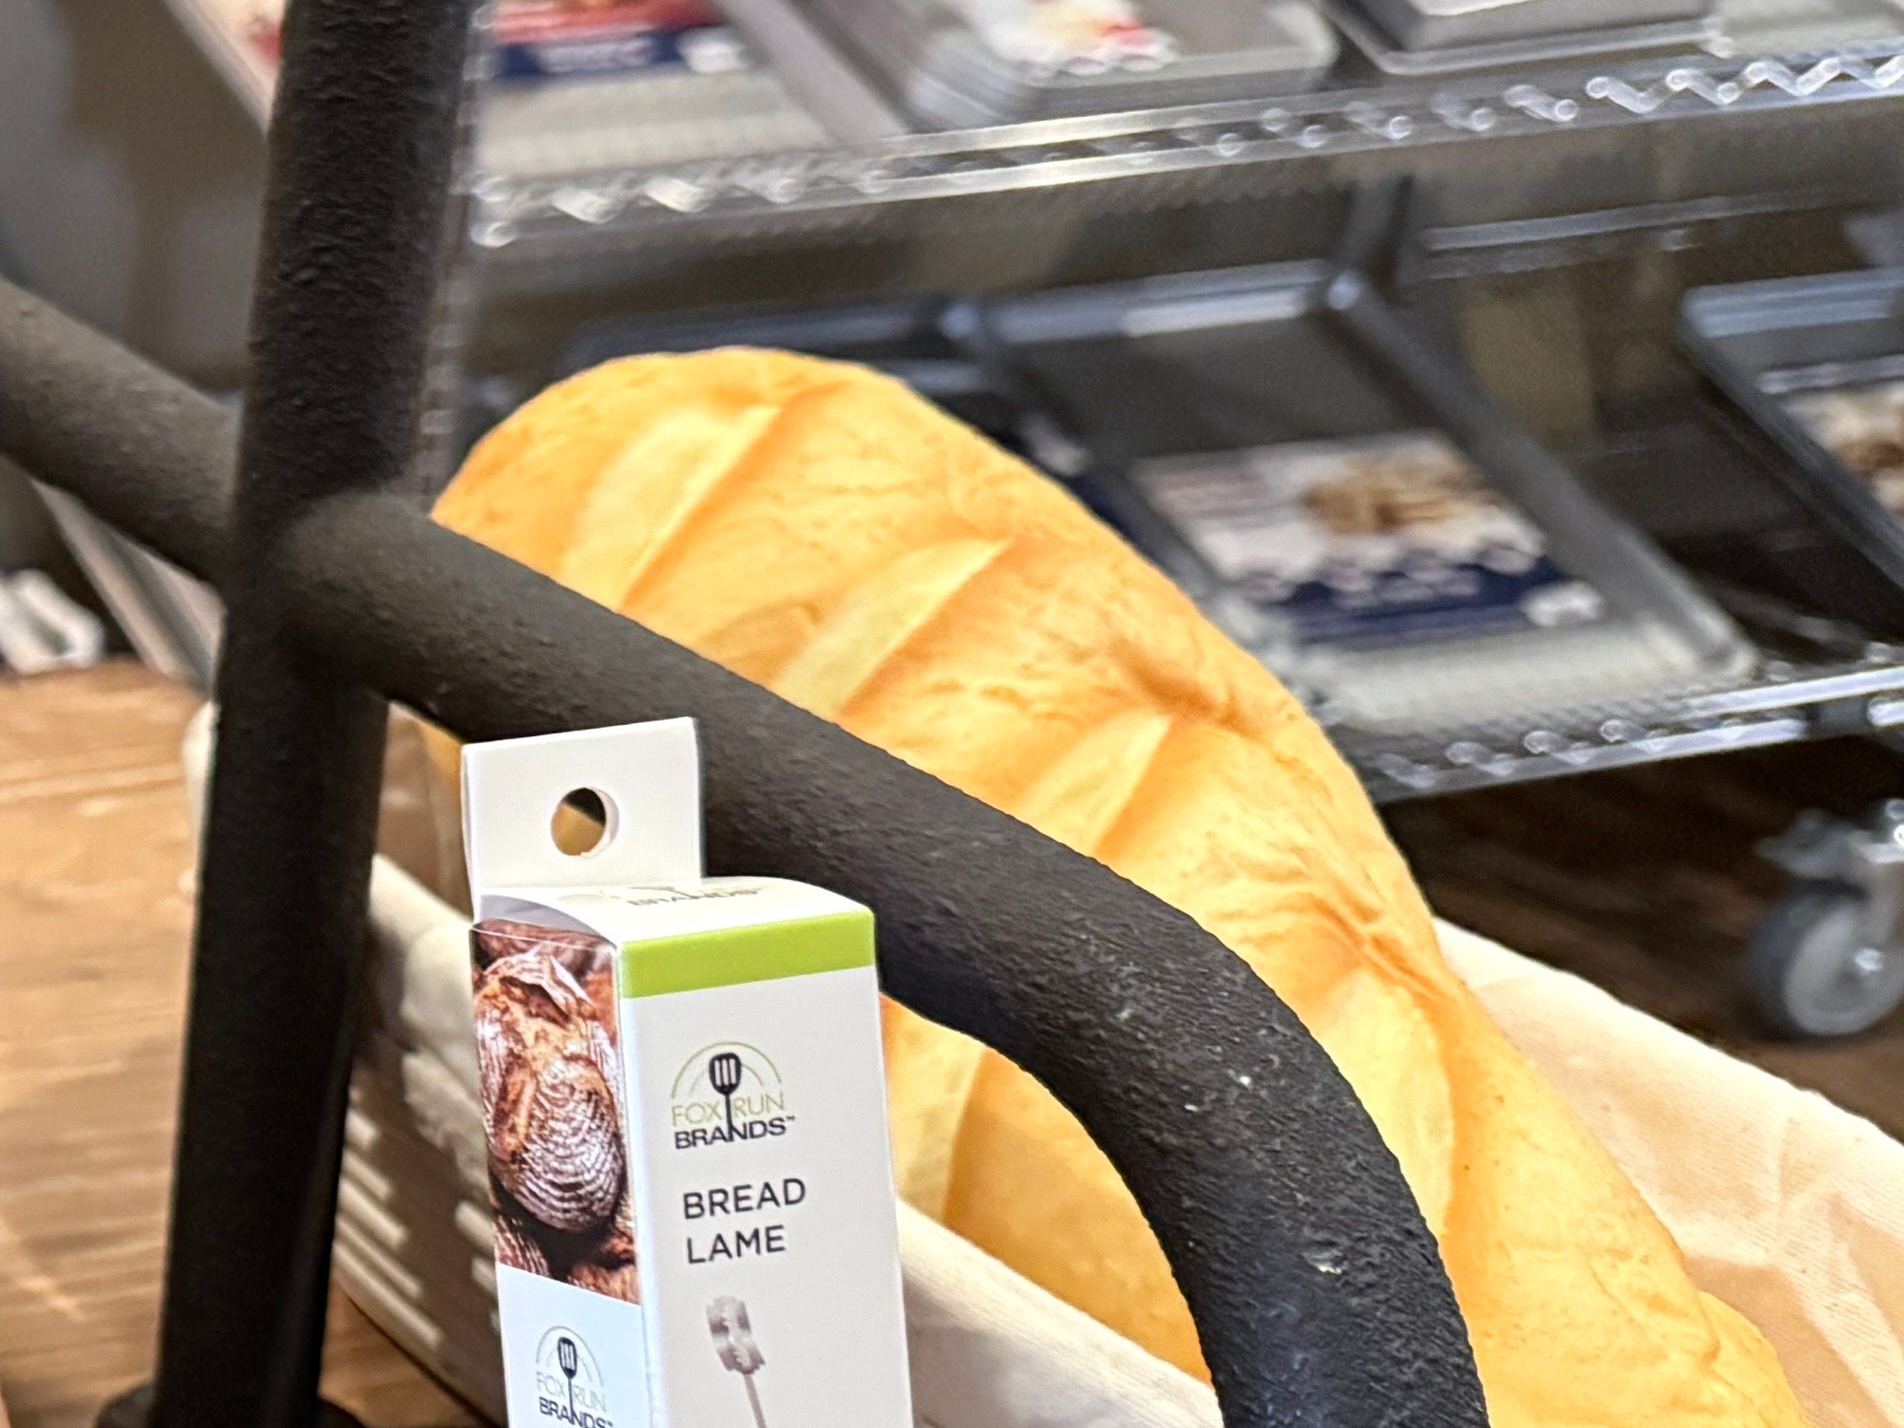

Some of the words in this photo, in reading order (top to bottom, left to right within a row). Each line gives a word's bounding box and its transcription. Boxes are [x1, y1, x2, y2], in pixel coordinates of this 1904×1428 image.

[671, 1099, 722, 1127] FOX
[732, 1089, 786, 1118] RUN
[683, 1177, 807, 1220] BREAD
[686, 1224, 787, 1264] LAME
[536, 1371, 567, 1399] FOX
[572, 1384, 607, 1413] RUN
